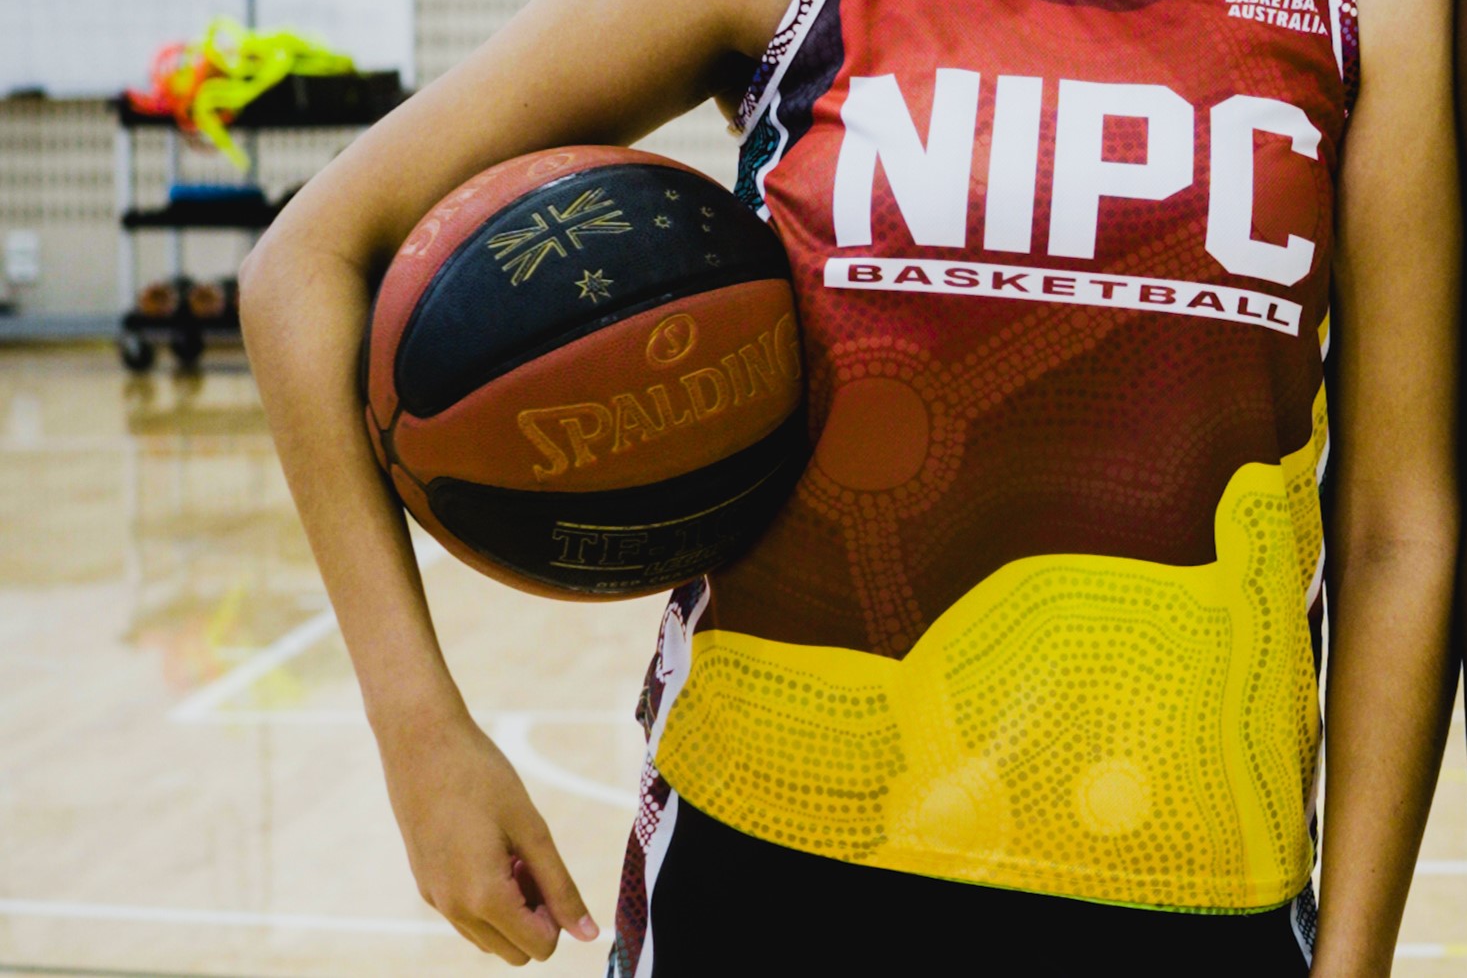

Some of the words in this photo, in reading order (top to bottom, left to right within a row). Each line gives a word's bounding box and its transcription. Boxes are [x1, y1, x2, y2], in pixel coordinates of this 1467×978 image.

[833, 68, 1322, 286] NIPC
[847, 263, 1293, 327] BASKETBALL
[518, 311, 802, 482] SPALDING
